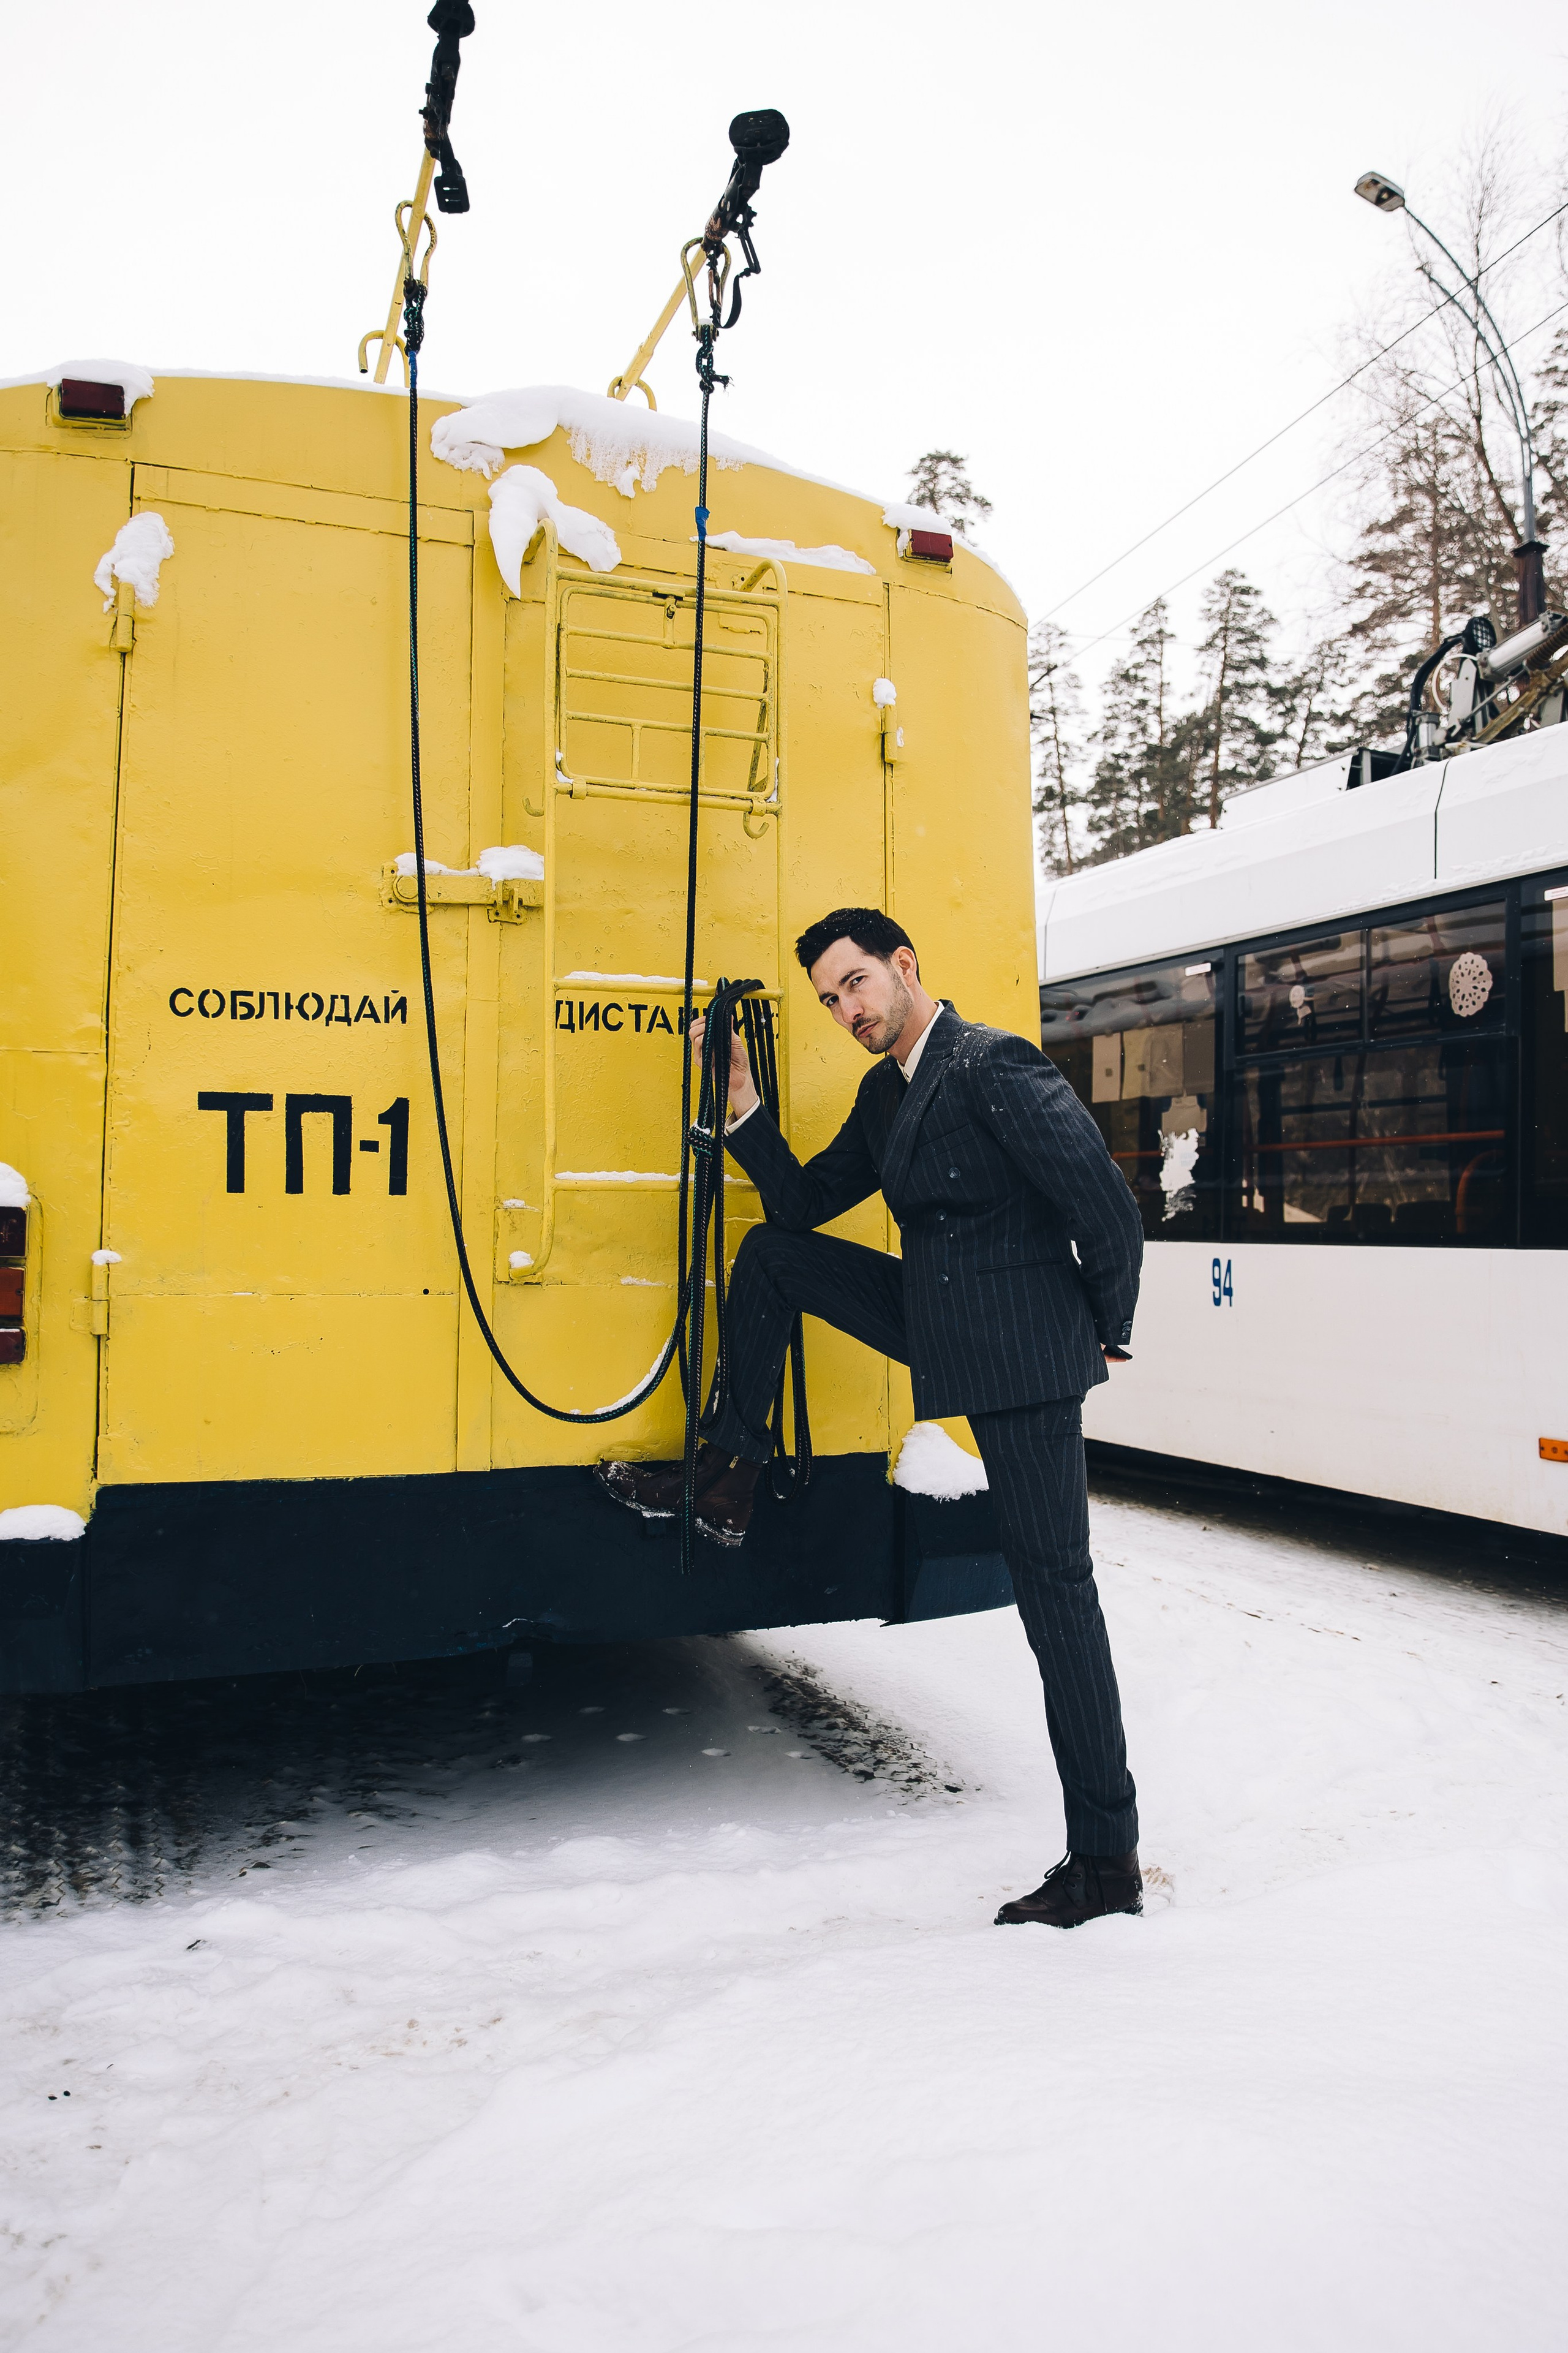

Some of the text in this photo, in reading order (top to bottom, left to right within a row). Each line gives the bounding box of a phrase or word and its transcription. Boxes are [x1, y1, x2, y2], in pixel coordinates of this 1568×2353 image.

[169, 987, 407, 1027] СОБЛЮДАЙ
[197, 1091, 410, 1196] ТП-1
[1212, 1258, 1234, 1307] 94
